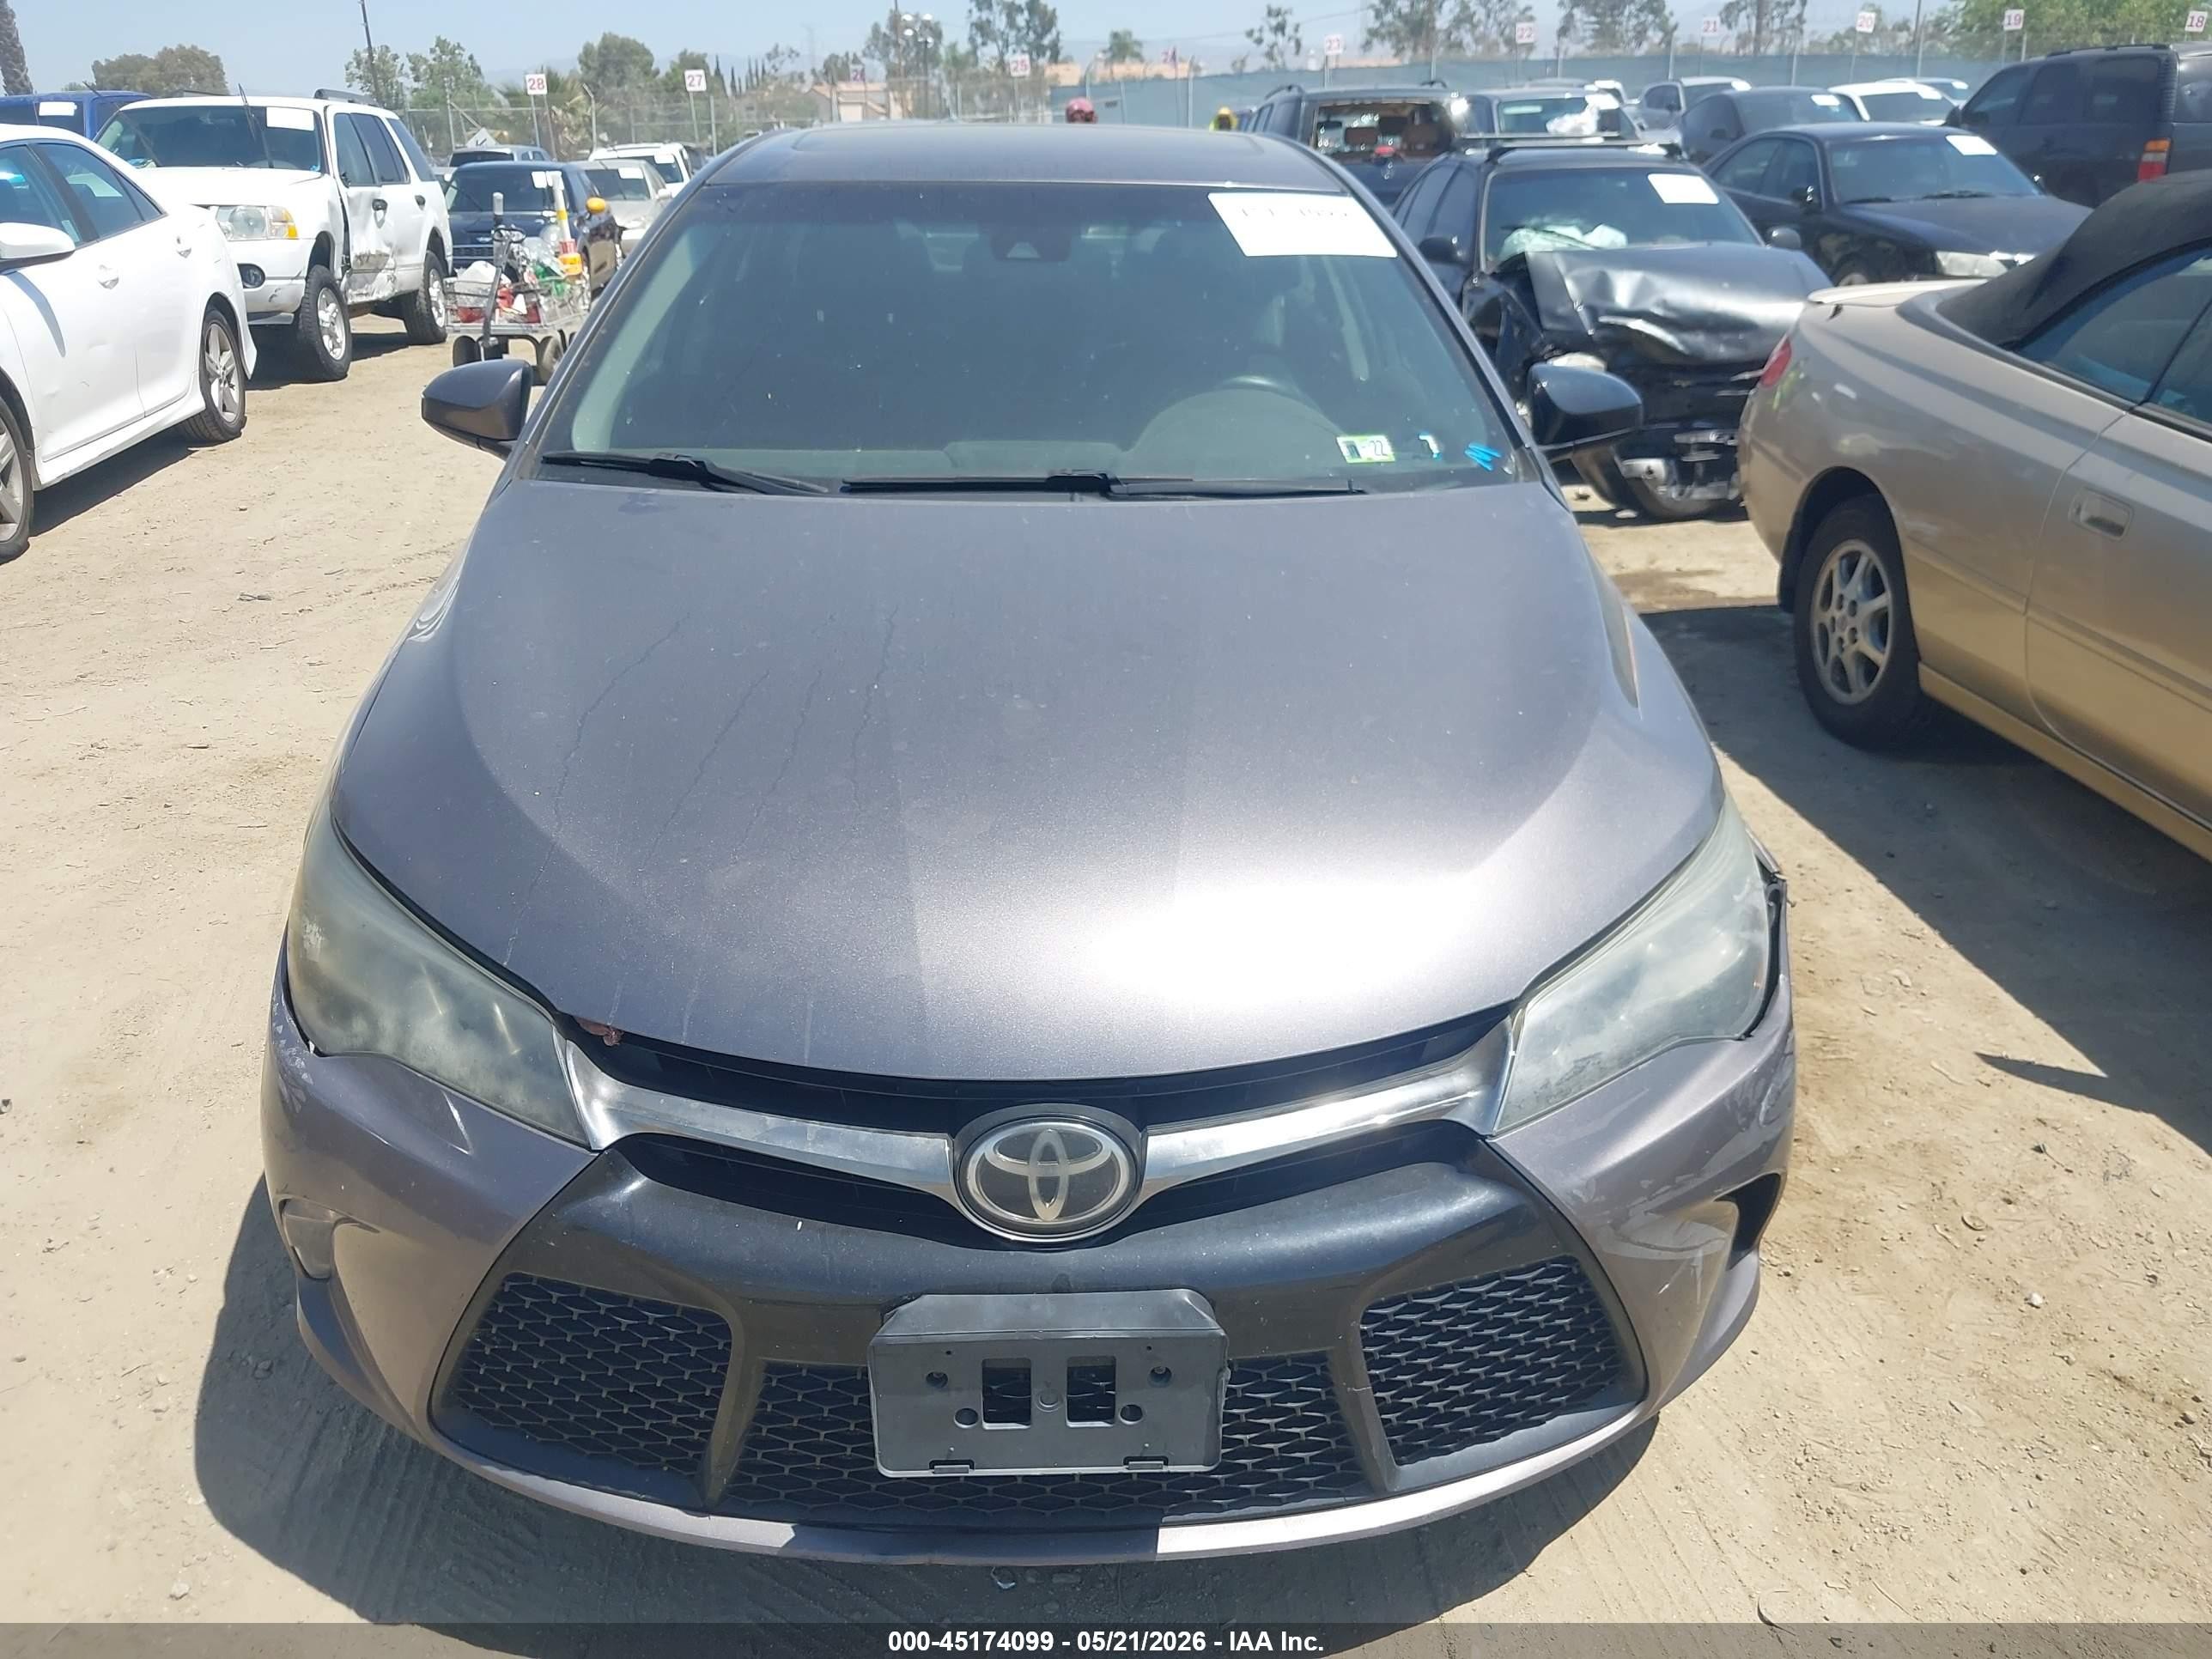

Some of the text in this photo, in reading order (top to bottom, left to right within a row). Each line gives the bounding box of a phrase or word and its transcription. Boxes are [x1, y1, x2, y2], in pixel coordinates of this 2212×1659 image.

[2007, 14, 2021, 26] 19
[2187, 15, 2204, 27] 18
[528, 77, 545, 90] 28
[687, 74, 702, 88] 27
